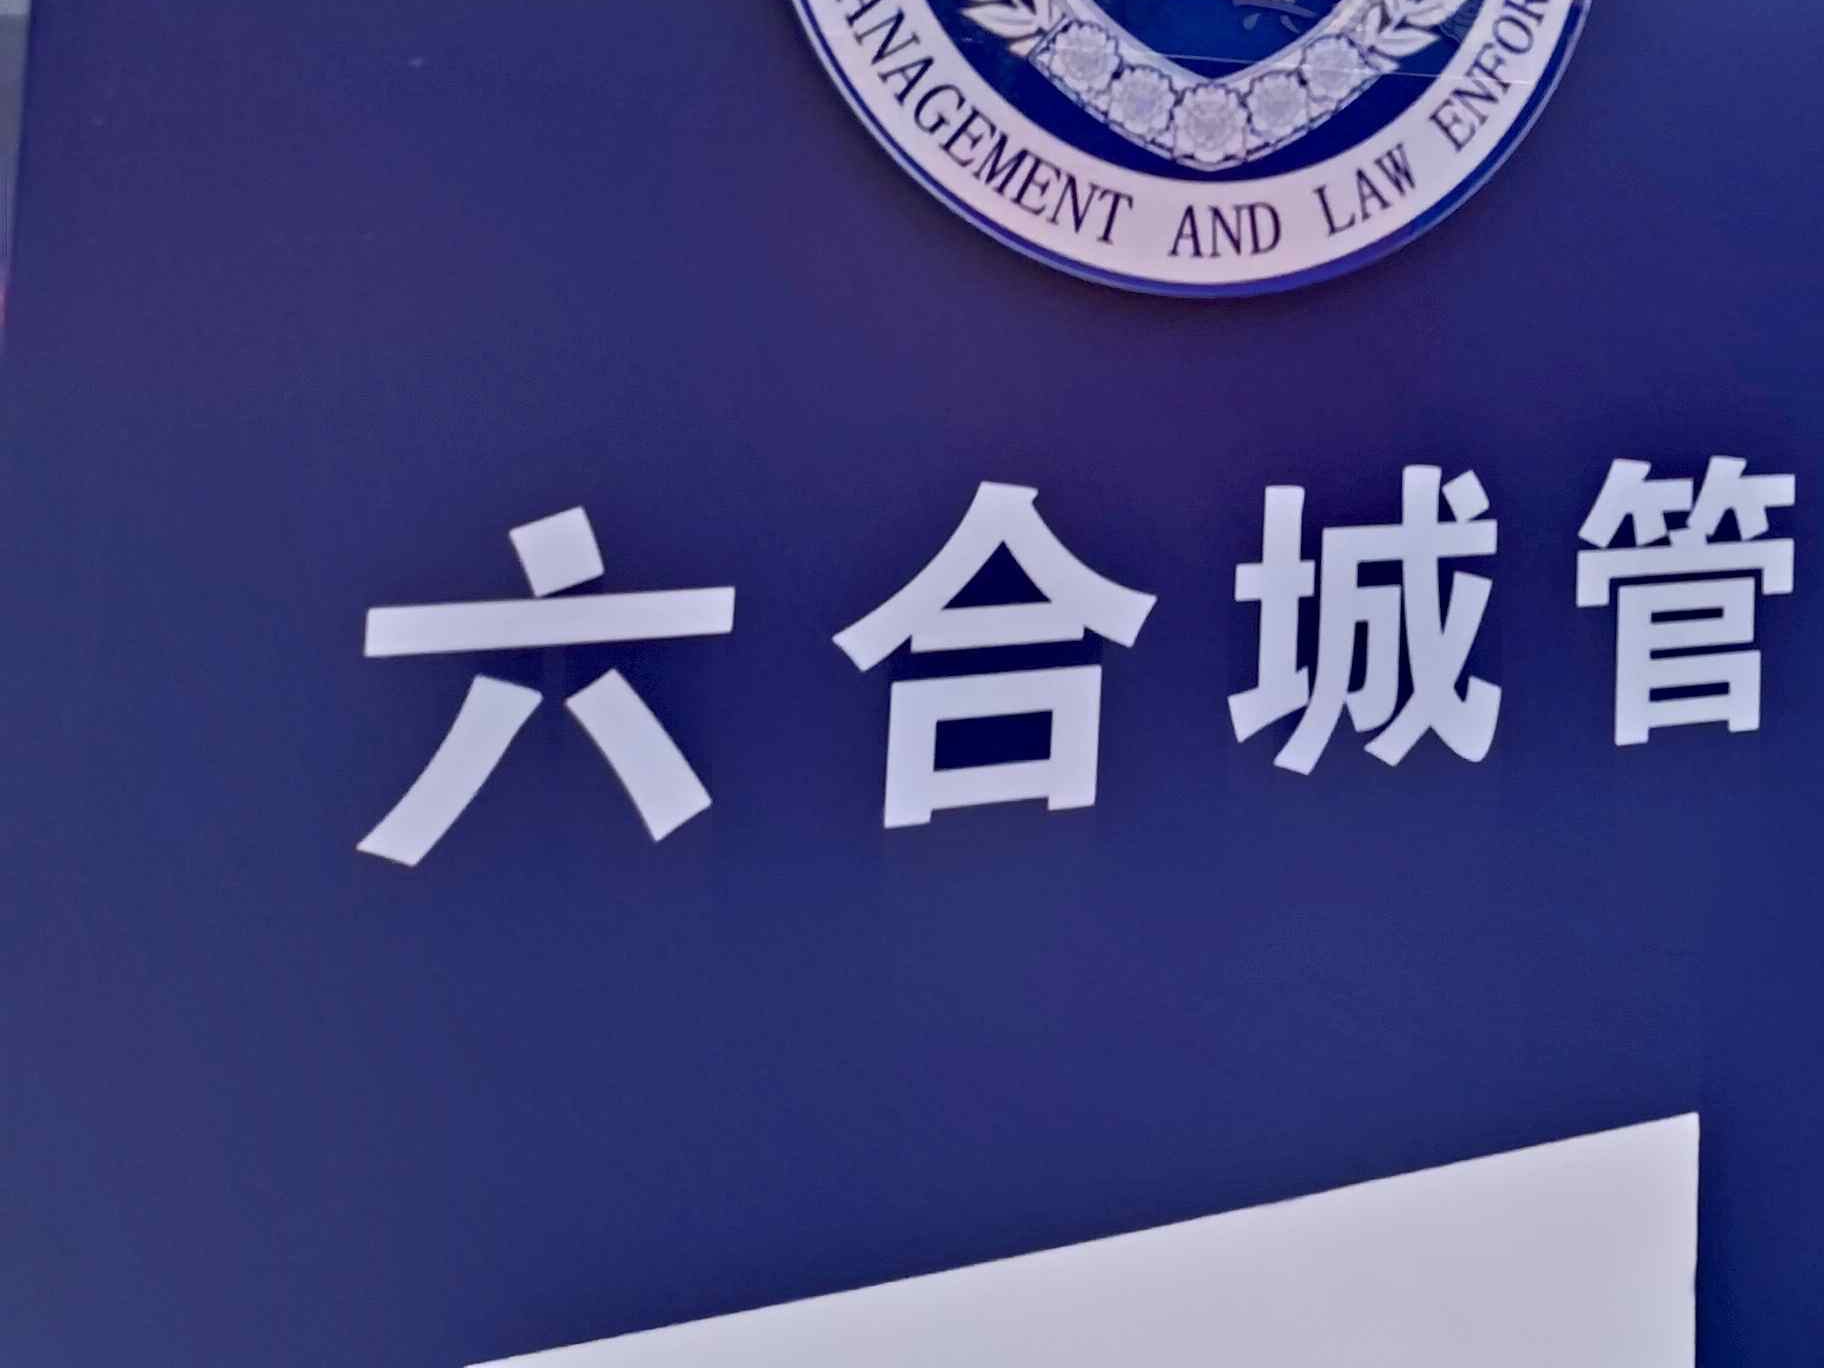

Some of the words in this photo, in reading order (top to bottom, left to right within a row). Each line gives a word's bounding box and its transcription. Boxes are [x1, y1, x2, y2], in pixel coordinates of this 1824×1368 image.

[1168, 201, 1282, 259] AND
[1313, 143, 1417, 237] LAW
[356, 456, 1796, 867] 六合城管
